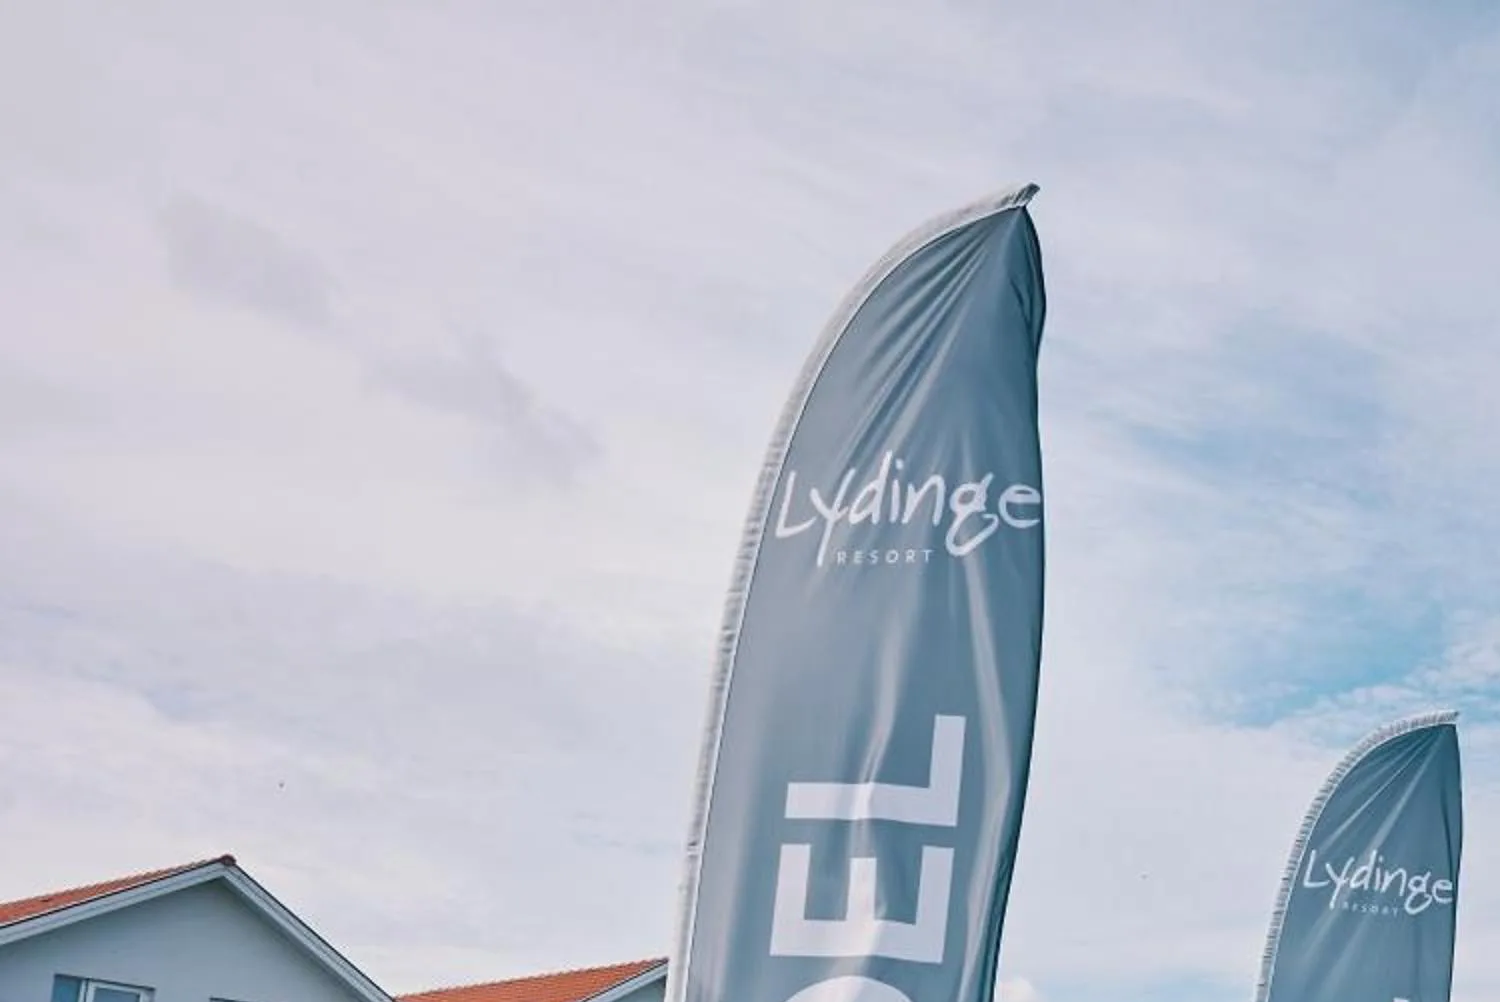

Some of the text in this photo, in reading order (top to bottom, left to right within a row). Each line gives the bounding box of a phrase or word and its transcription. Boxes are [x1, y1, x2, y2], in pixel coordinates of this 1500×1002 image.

[775, 450, 1042, 567] Lydinge
[836, 549, 934, 565] RESORT
[1303, 849, 1453, 915] Lydinge
